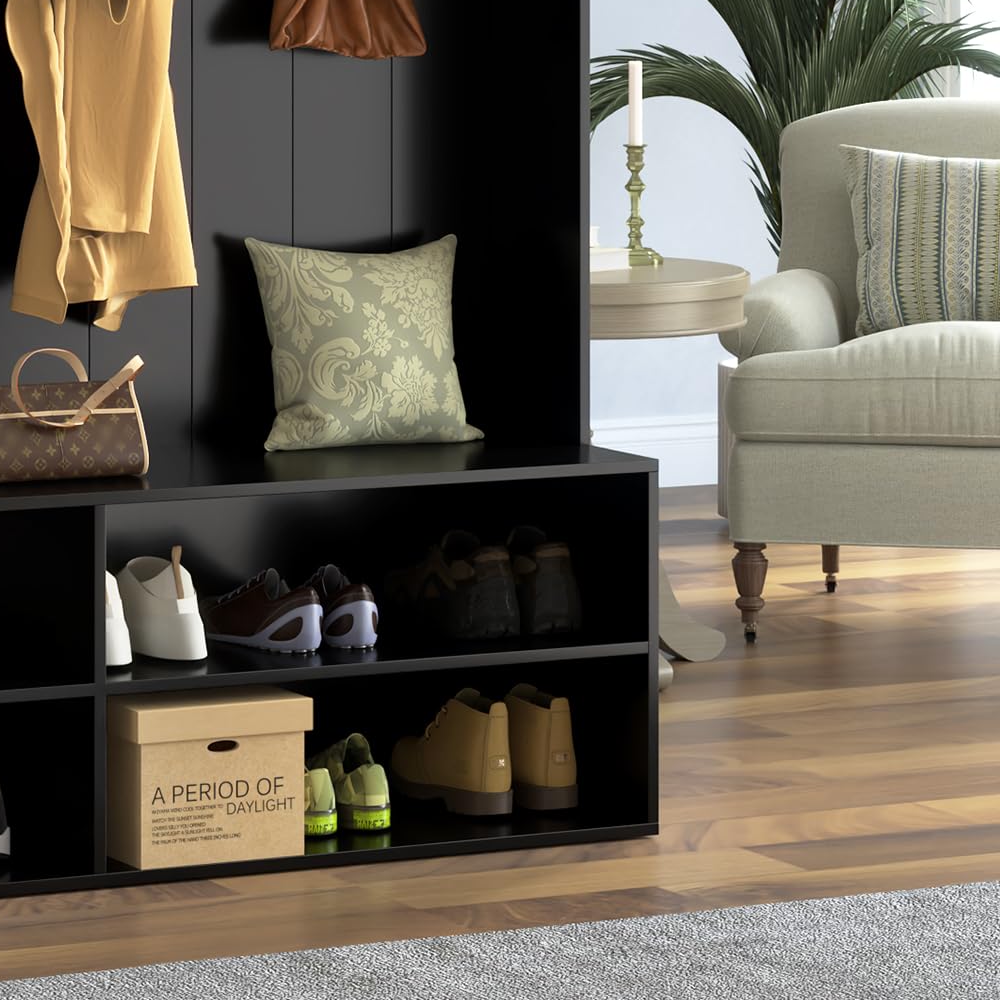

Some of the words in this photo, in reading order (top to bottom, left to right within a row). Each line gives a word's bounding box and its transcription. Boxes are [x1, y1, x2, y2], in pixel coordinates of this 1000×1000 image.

[151, 787, 166, 805] A
[172, 780, 250, 804] PERIOD
[256, 776, 285, 796] OF
[226, 796, 296, 815] DAYLIGHT
